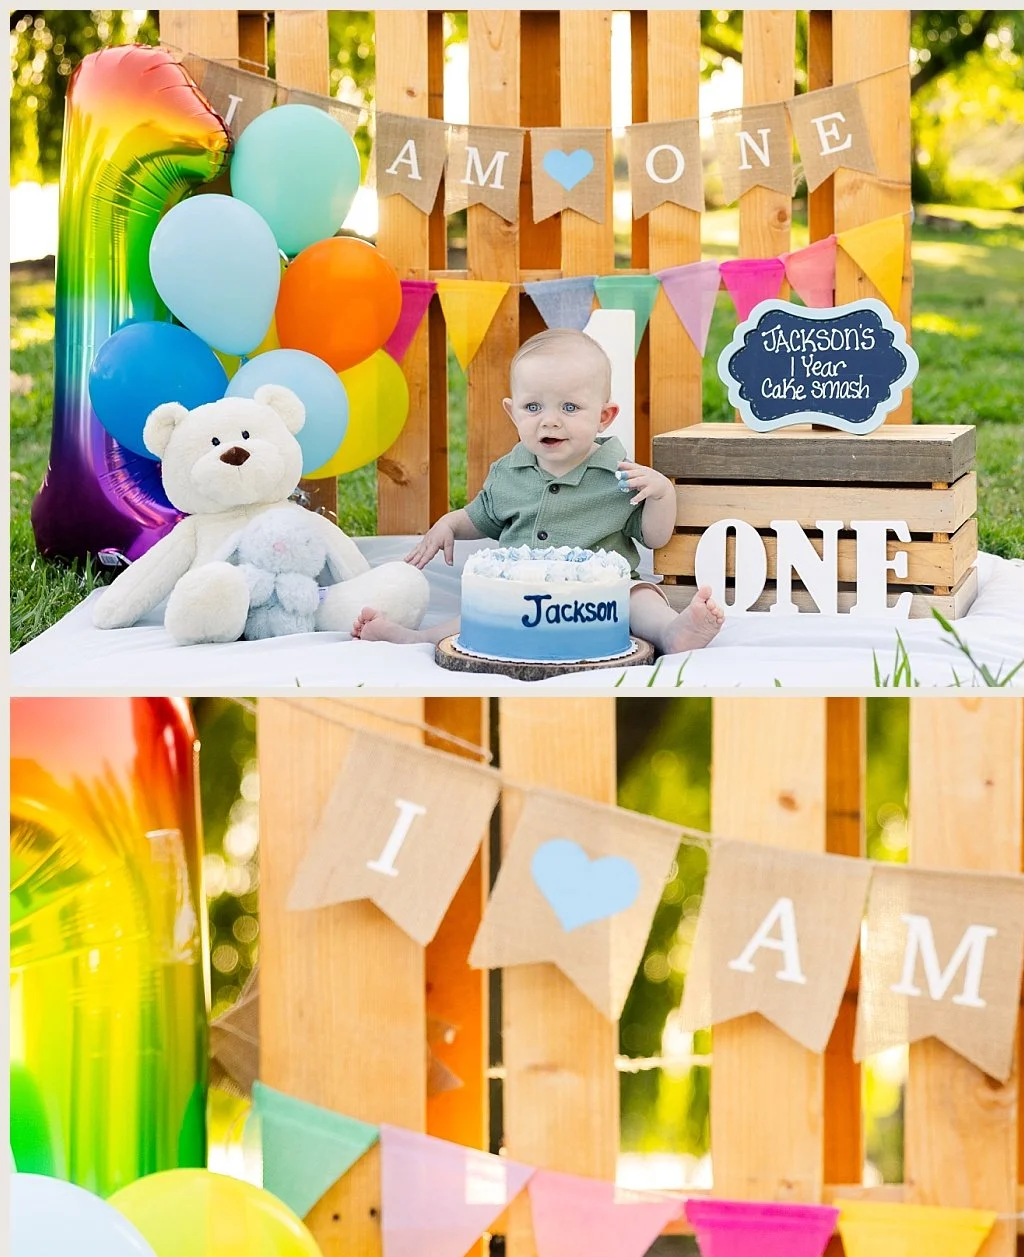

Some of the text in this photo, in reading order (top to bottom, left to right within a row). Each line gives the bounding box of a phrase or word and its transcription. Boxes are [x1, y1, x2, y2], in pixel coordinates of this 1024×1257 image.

[645, 111, 852, 184] ONE
[801, 354, 847, 377] Year
[695, 518, 913, 618] ONE
[521, 594, 619, 628] Jackson
[366, 799, 427, 877] I
